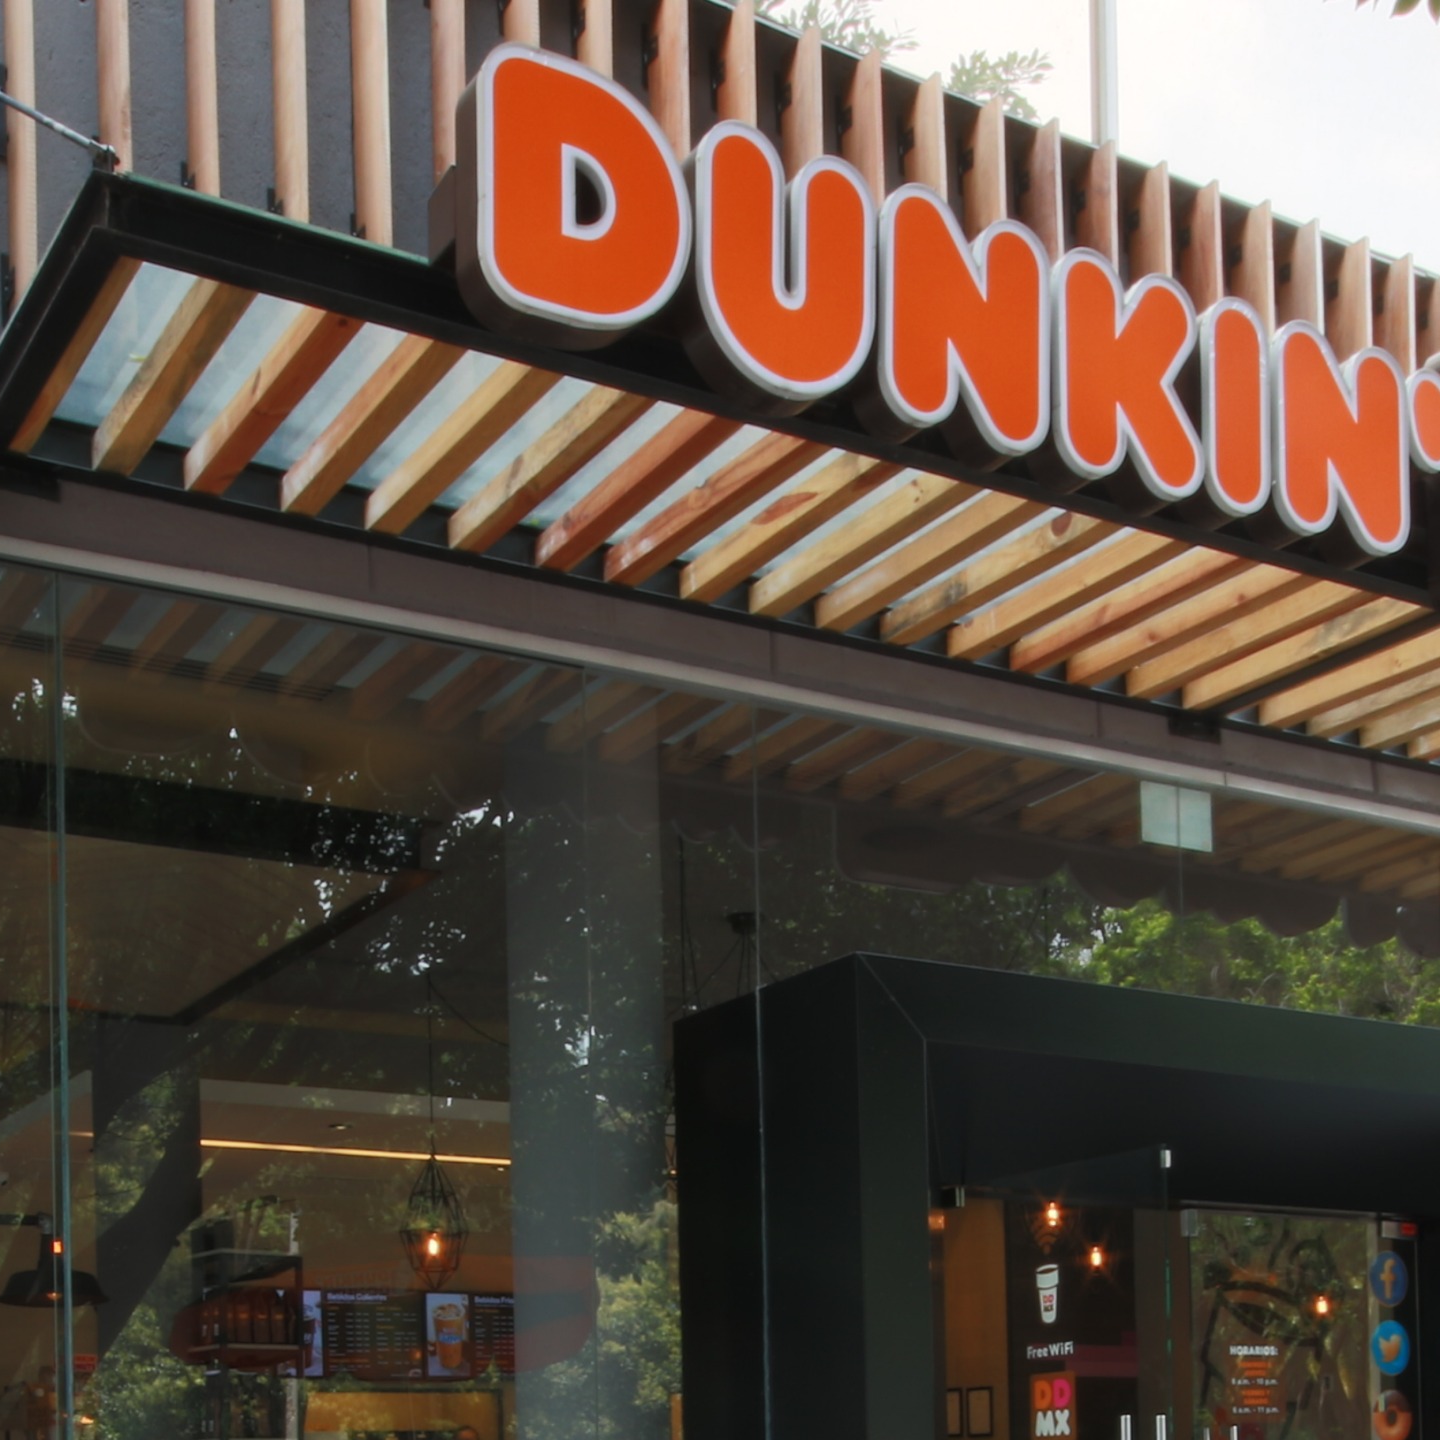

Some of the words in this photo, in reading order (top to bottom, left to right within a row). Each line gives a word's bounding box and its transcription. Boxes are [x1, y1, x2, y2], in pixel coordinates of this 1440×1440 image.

[1027, 1346, 1048, 1359] Free
[1049, 1341, 1074, 1356] WiFi
[1034, 1378, 1073, 1410] DD
[1035, 1409, 1071, 1437] MX
